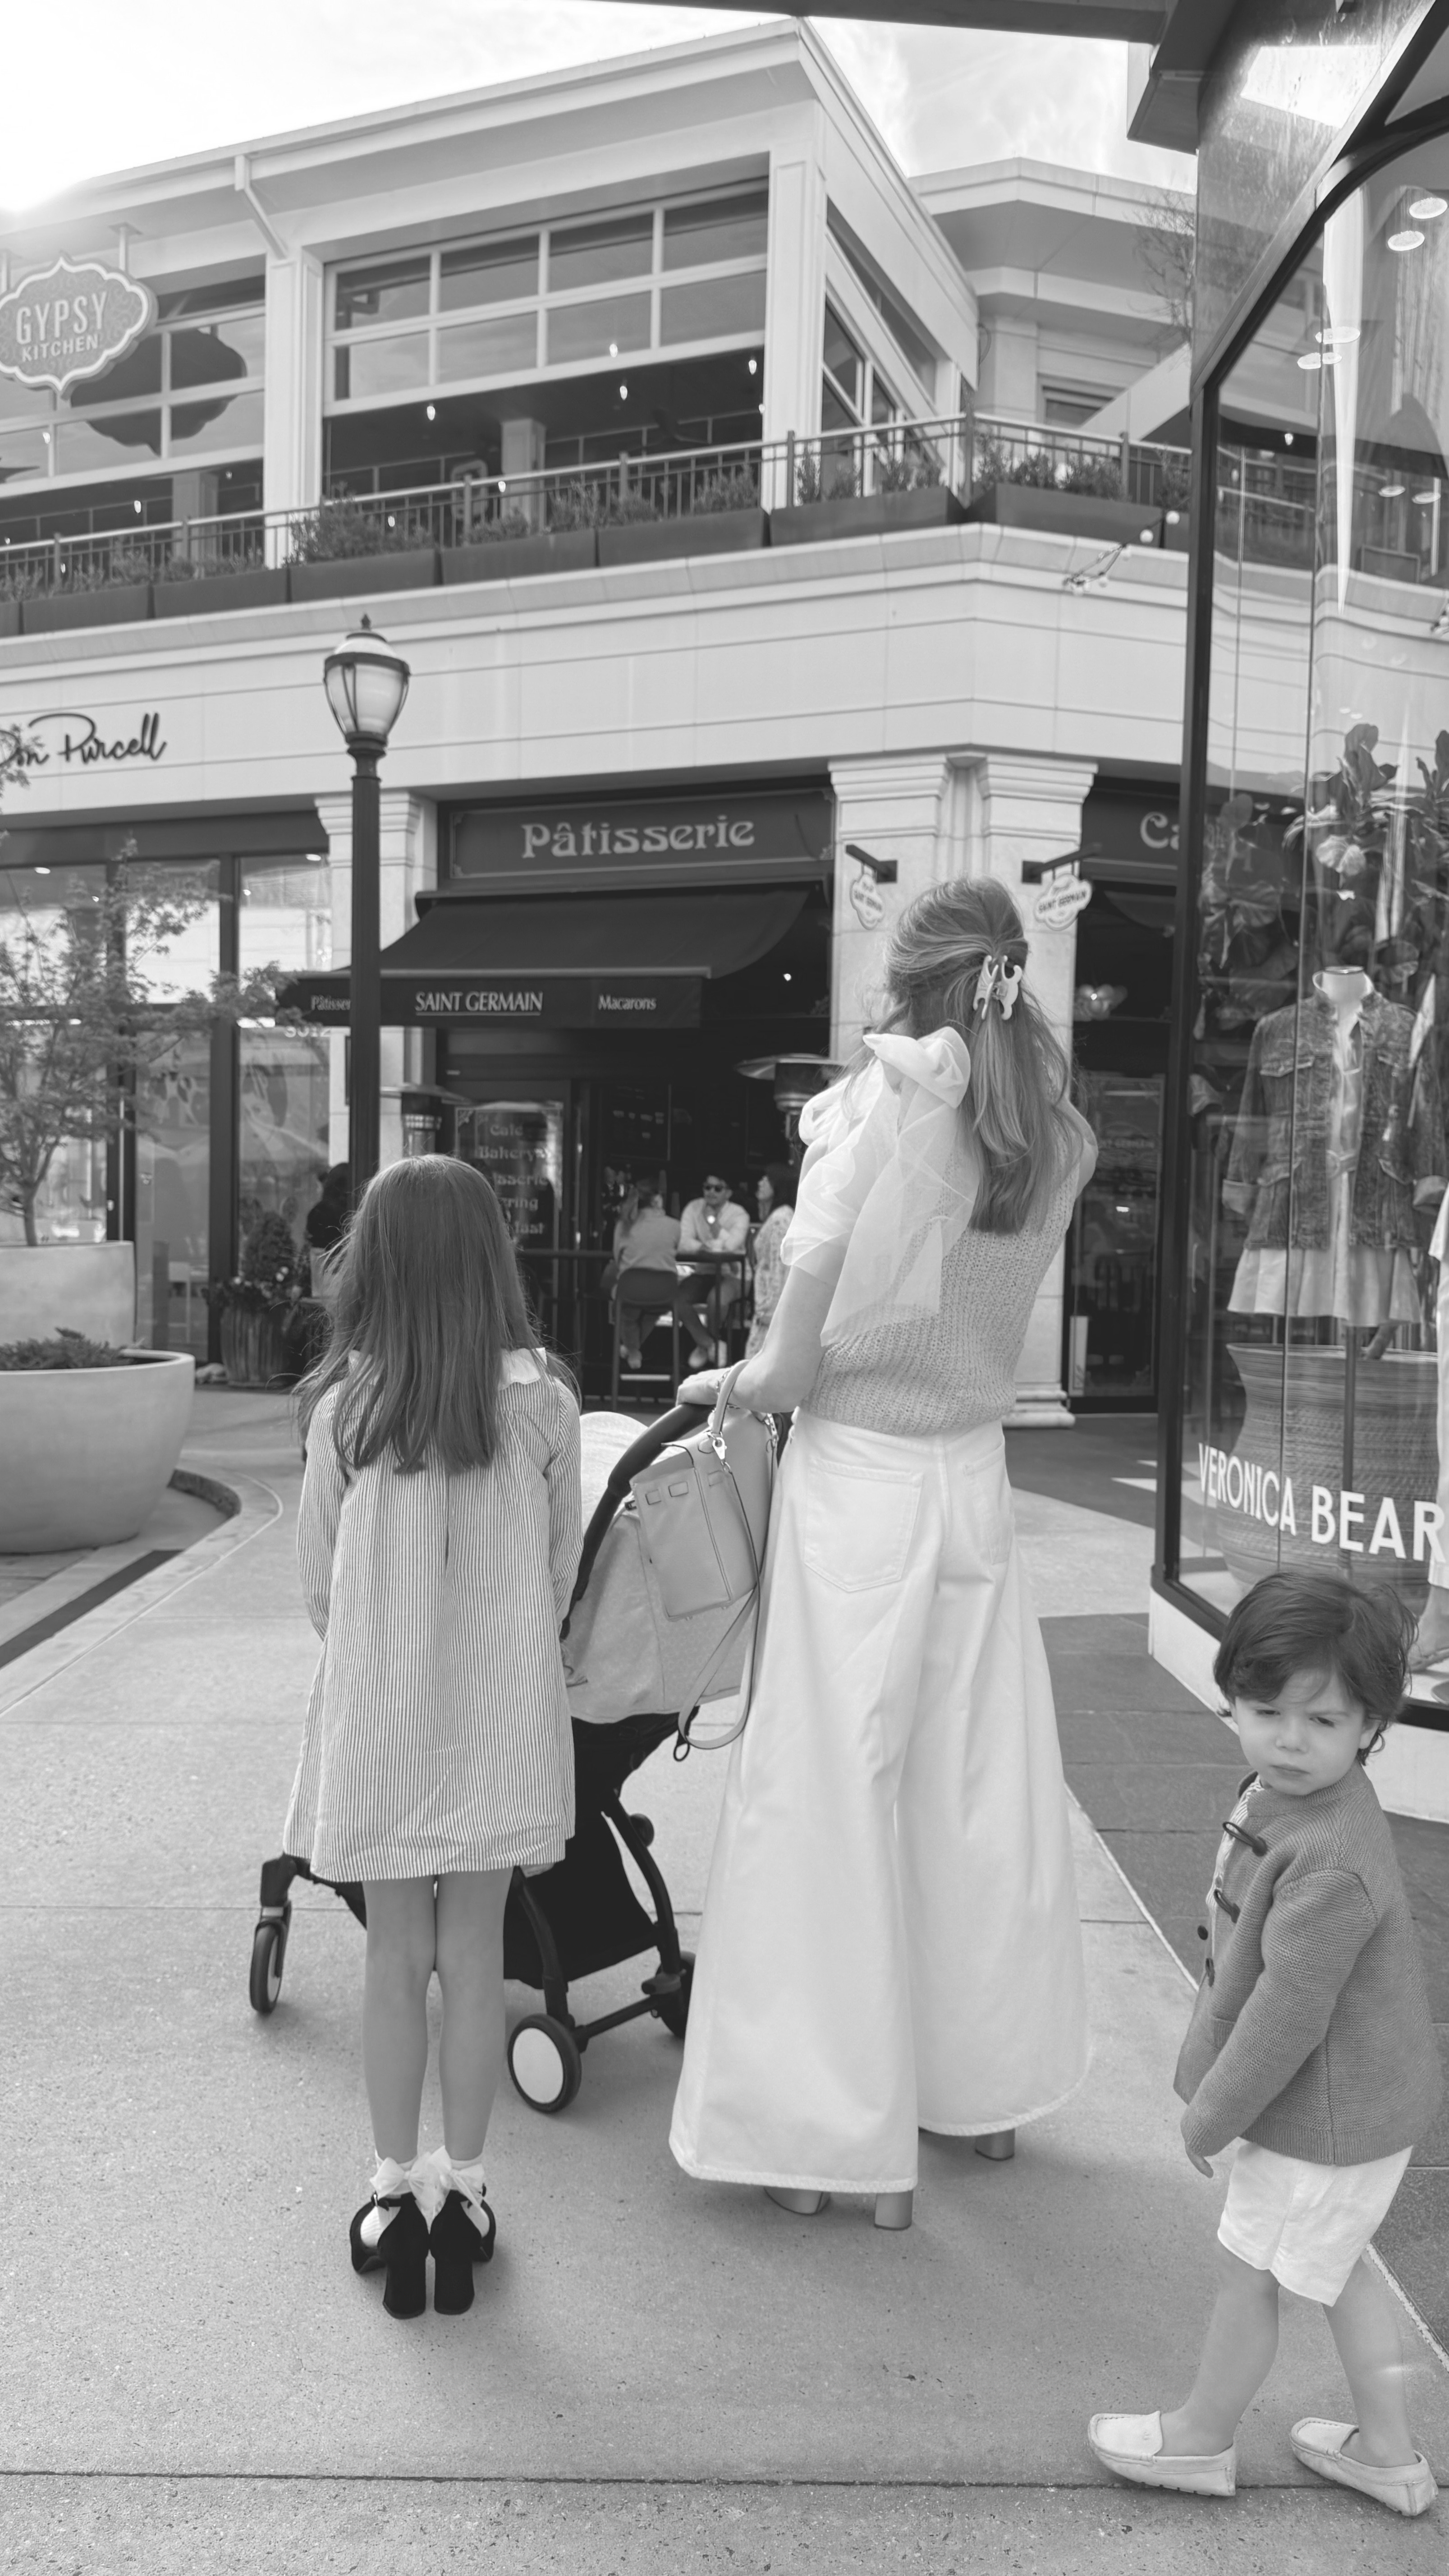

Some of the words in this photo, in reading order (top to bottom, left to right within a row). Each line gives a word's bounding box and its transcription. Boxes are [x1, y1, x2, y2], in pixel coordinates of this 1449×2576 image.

[16, 291, 106, 345] GYPSY
[22, 334, 98, 362] KITCHEN
[28, 712, 167, 764] Purcell
[520, 814, 755, 858] Pâtisserie
[311, 994, 351, 1011] Pâtisser
[414, 991, 463, 1012] SAINT
[465, 991, 543, 1012] GERMAIN
[598, 994, 657, 1011] Macarons
[1198, 1442, 1297, 1536] VERONICA
[1311, 1484, 1447, 1563] BEAR
